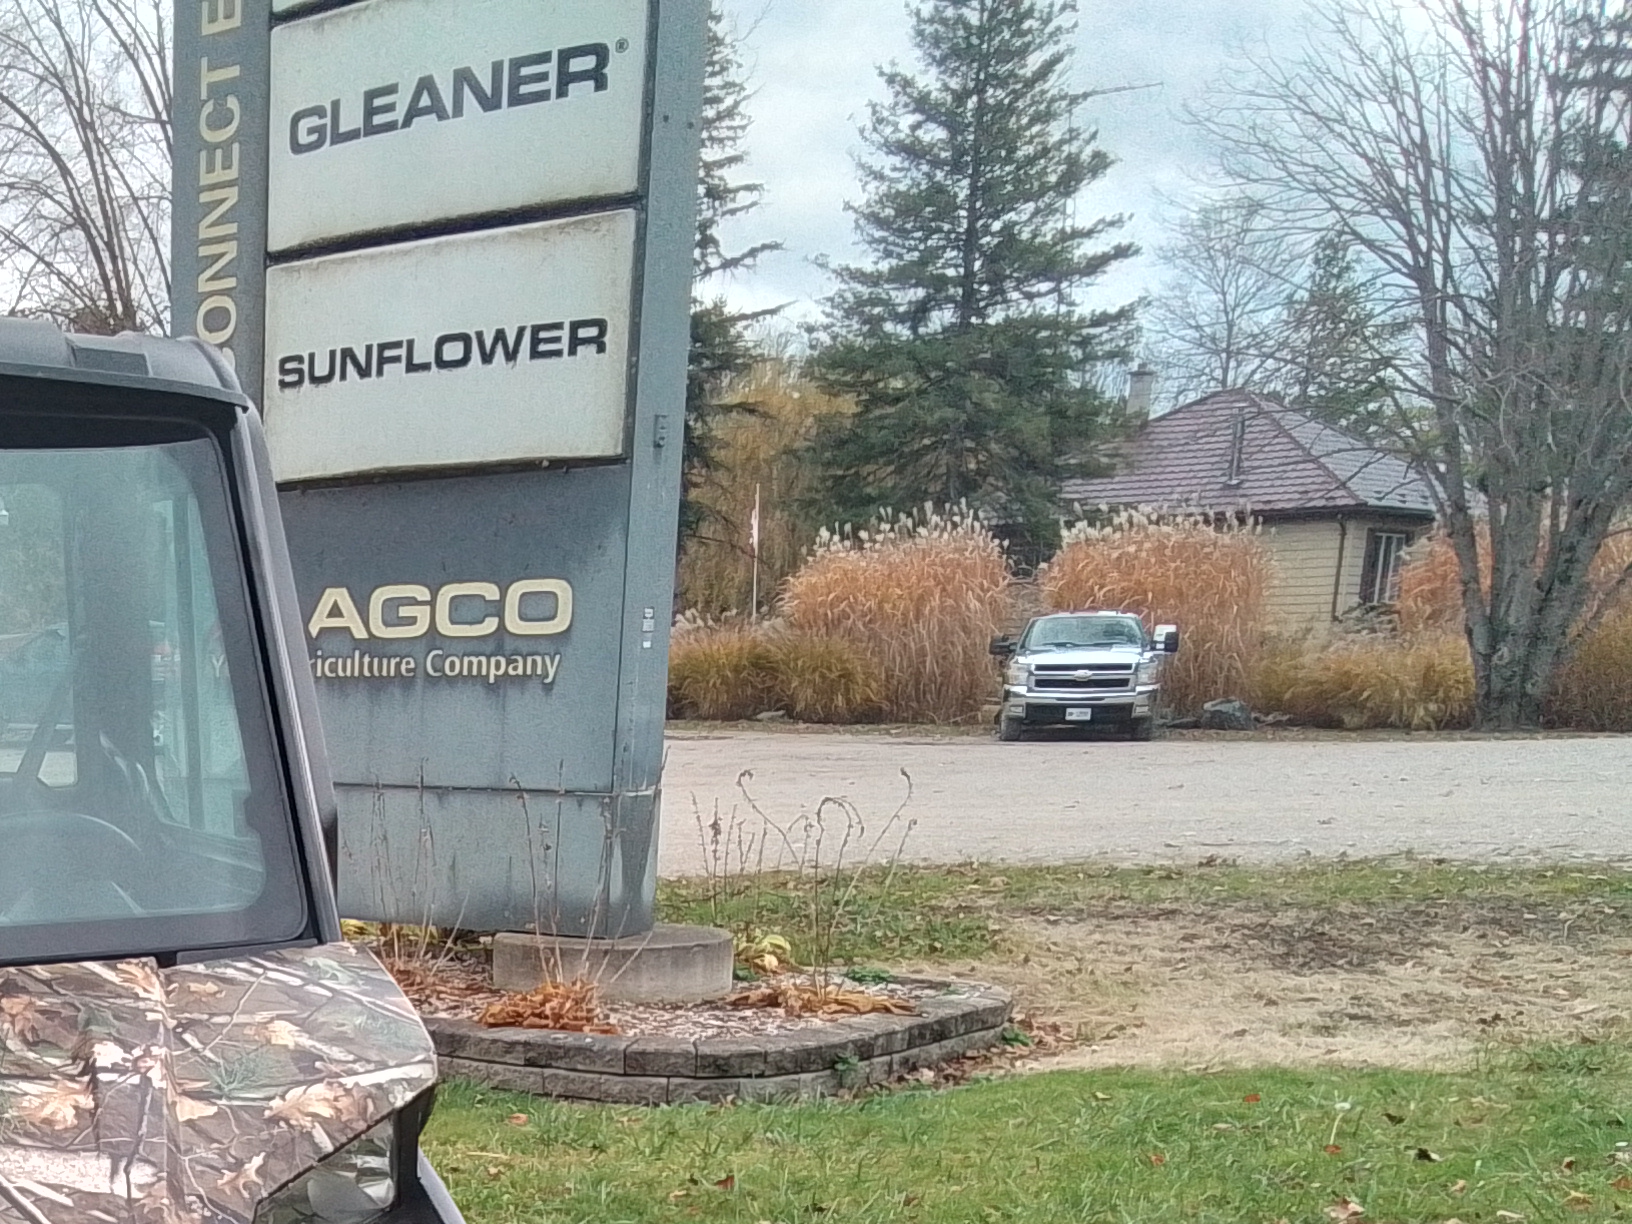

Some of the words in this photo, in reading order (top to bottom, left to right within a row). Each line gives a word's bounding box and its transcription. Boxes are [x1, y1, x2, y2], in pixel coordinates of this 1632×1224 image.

[196, 56, 241, 371] ONNECT
[277, 317, 608, 392] SUNFLOWER
[307, 578, 573, 640] AGCO
[425, 649, 561, 684] Company
